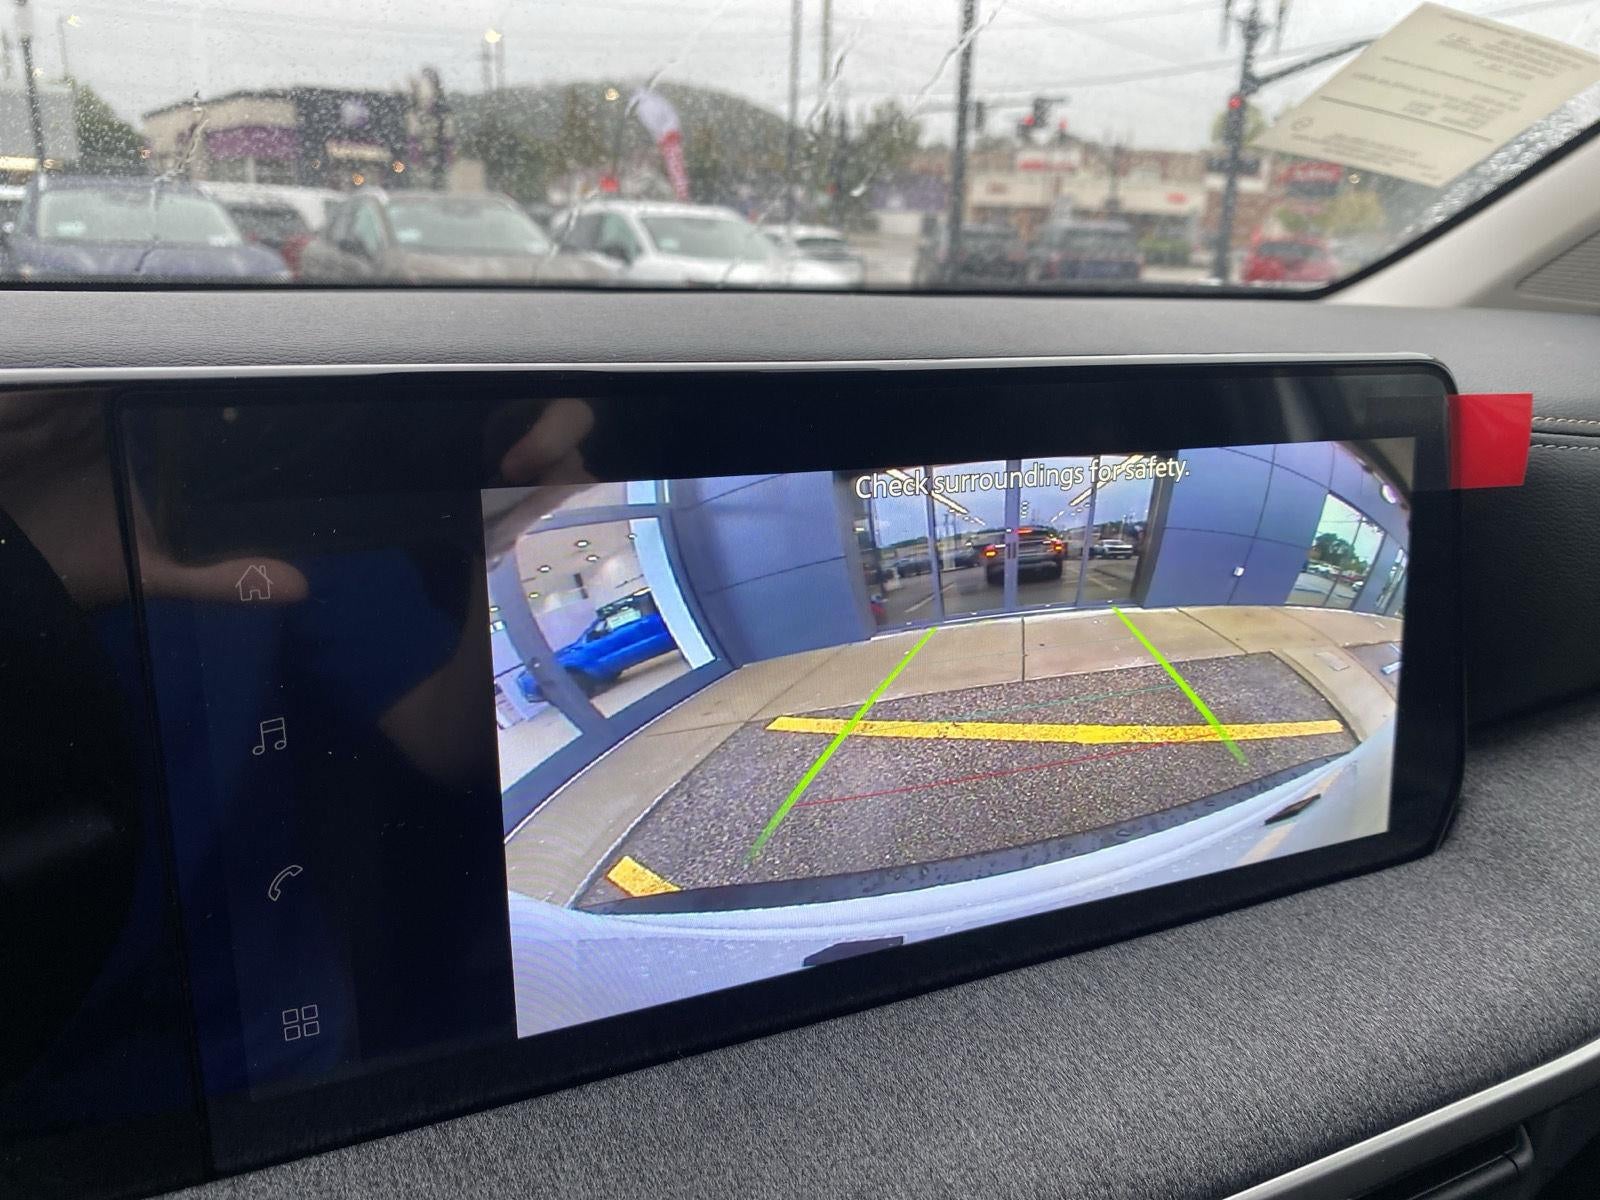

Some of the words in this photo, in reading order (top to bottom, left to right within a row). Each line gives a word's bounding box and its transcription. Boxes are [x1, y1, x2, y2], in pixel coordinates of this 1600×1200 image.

[855, 468, 929, 499] Check
[932, 462, 1084, 494] surroundings
[1089, 459, 1122, 483] for
[1124, 456, 1191, 481] safety.
